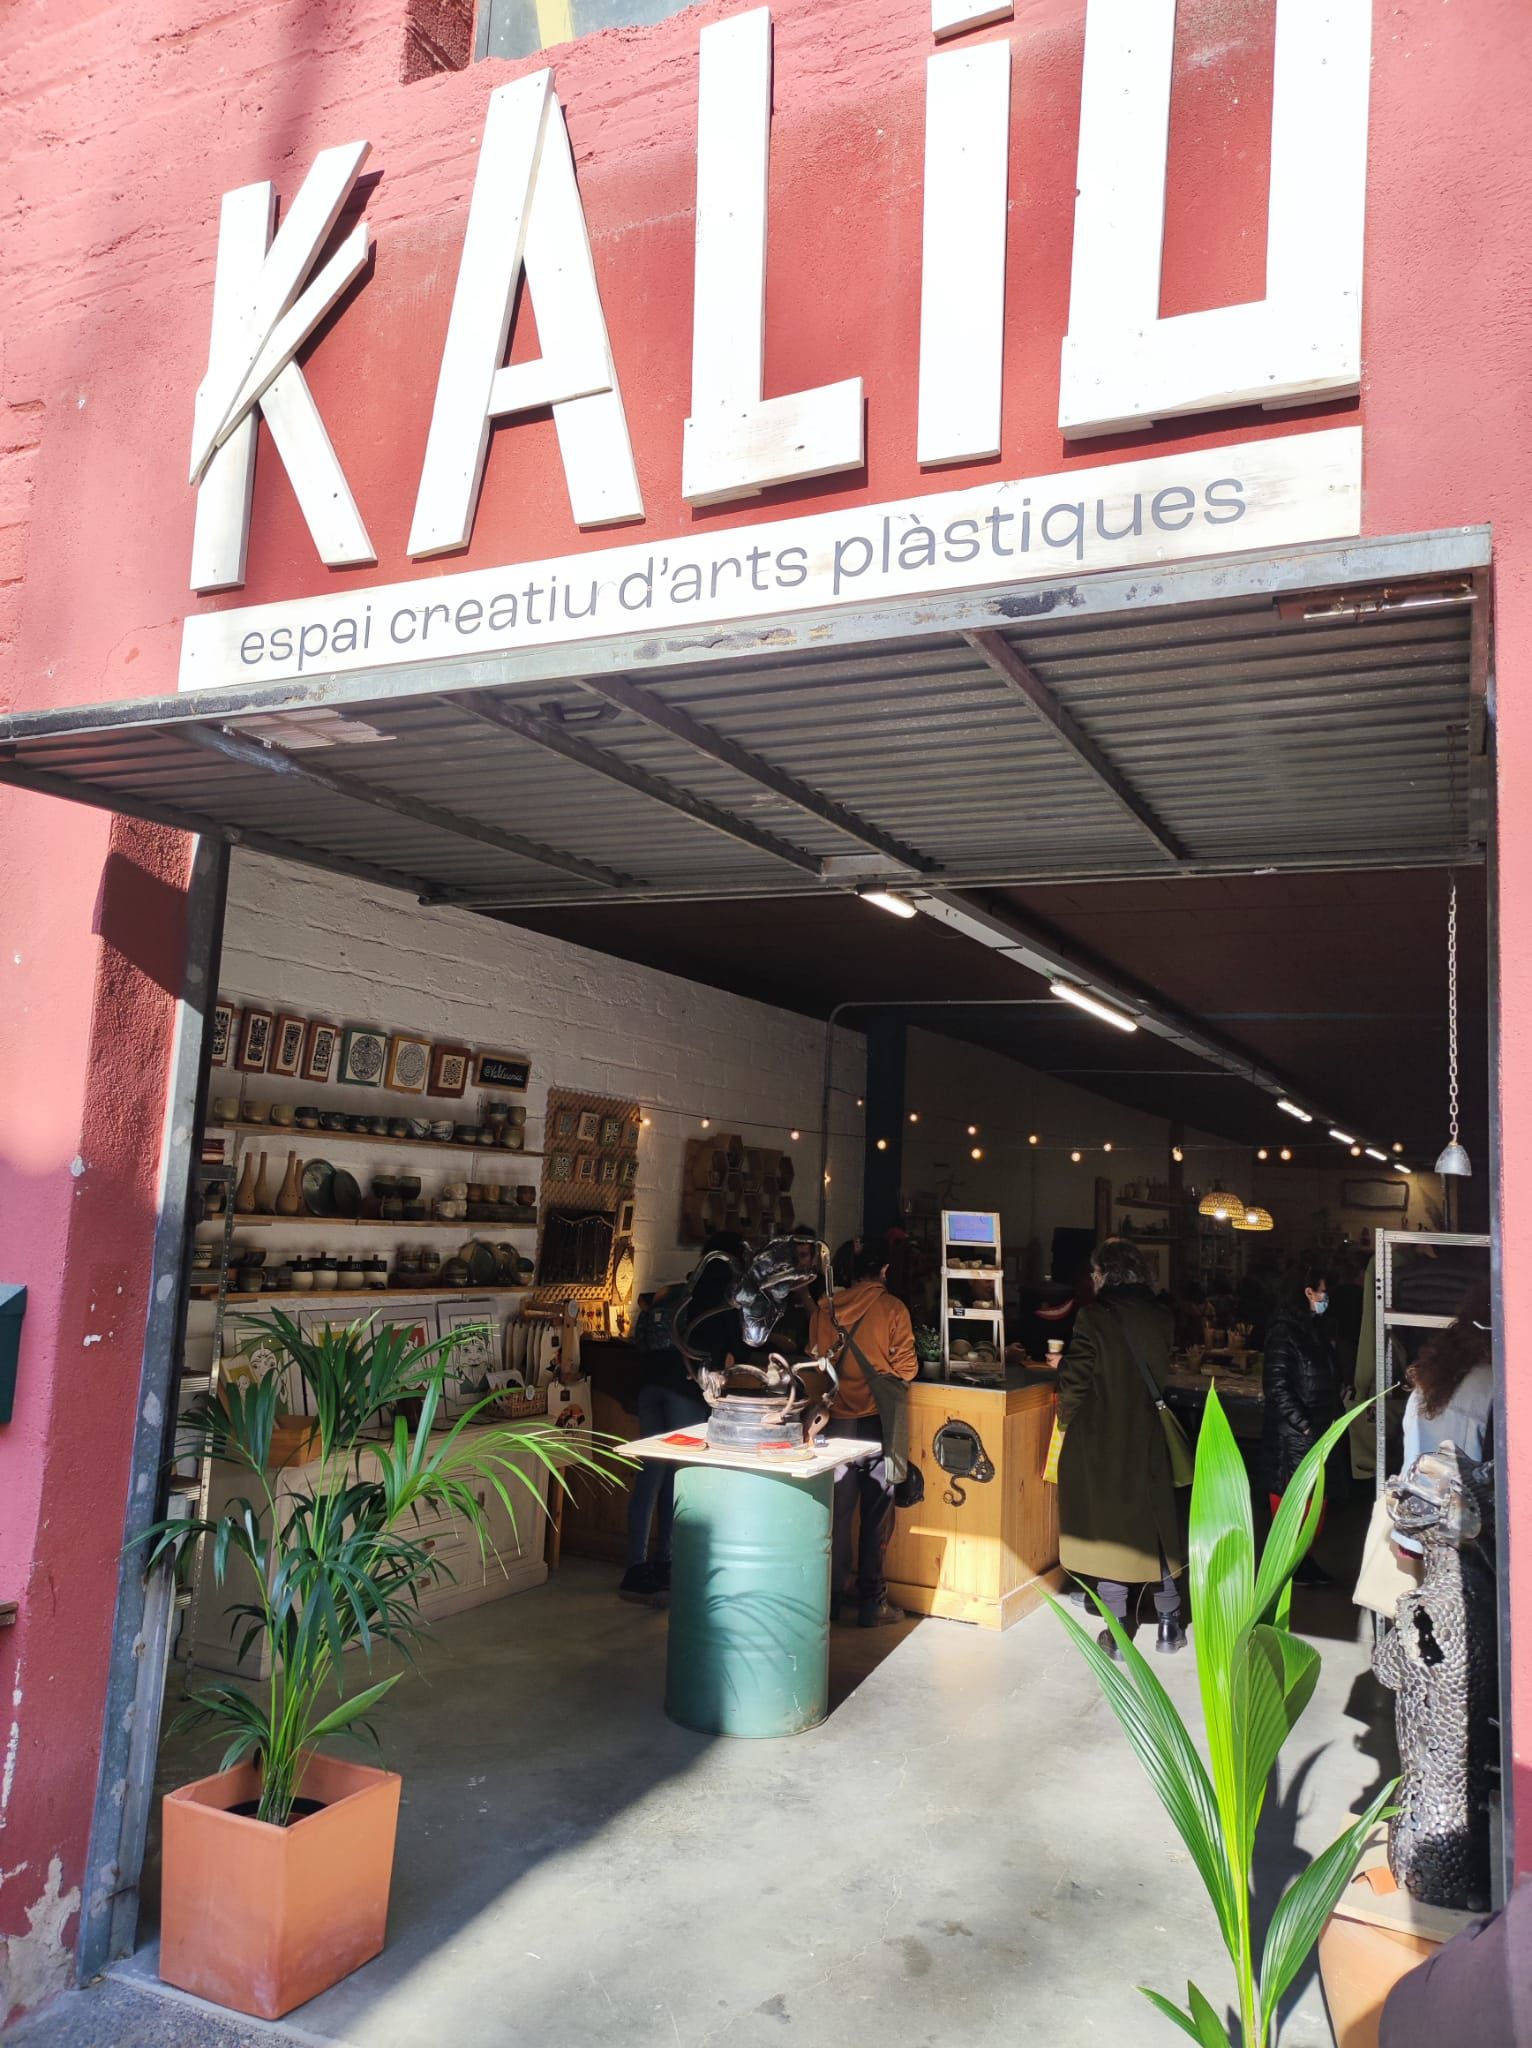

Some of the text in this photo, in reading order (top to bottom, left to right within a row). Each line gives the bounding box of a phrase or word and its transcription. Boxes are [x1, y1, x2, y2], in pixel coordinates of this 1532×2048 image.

[240, 478, 1246, 671] espai creatiu d'arts plàstiques
